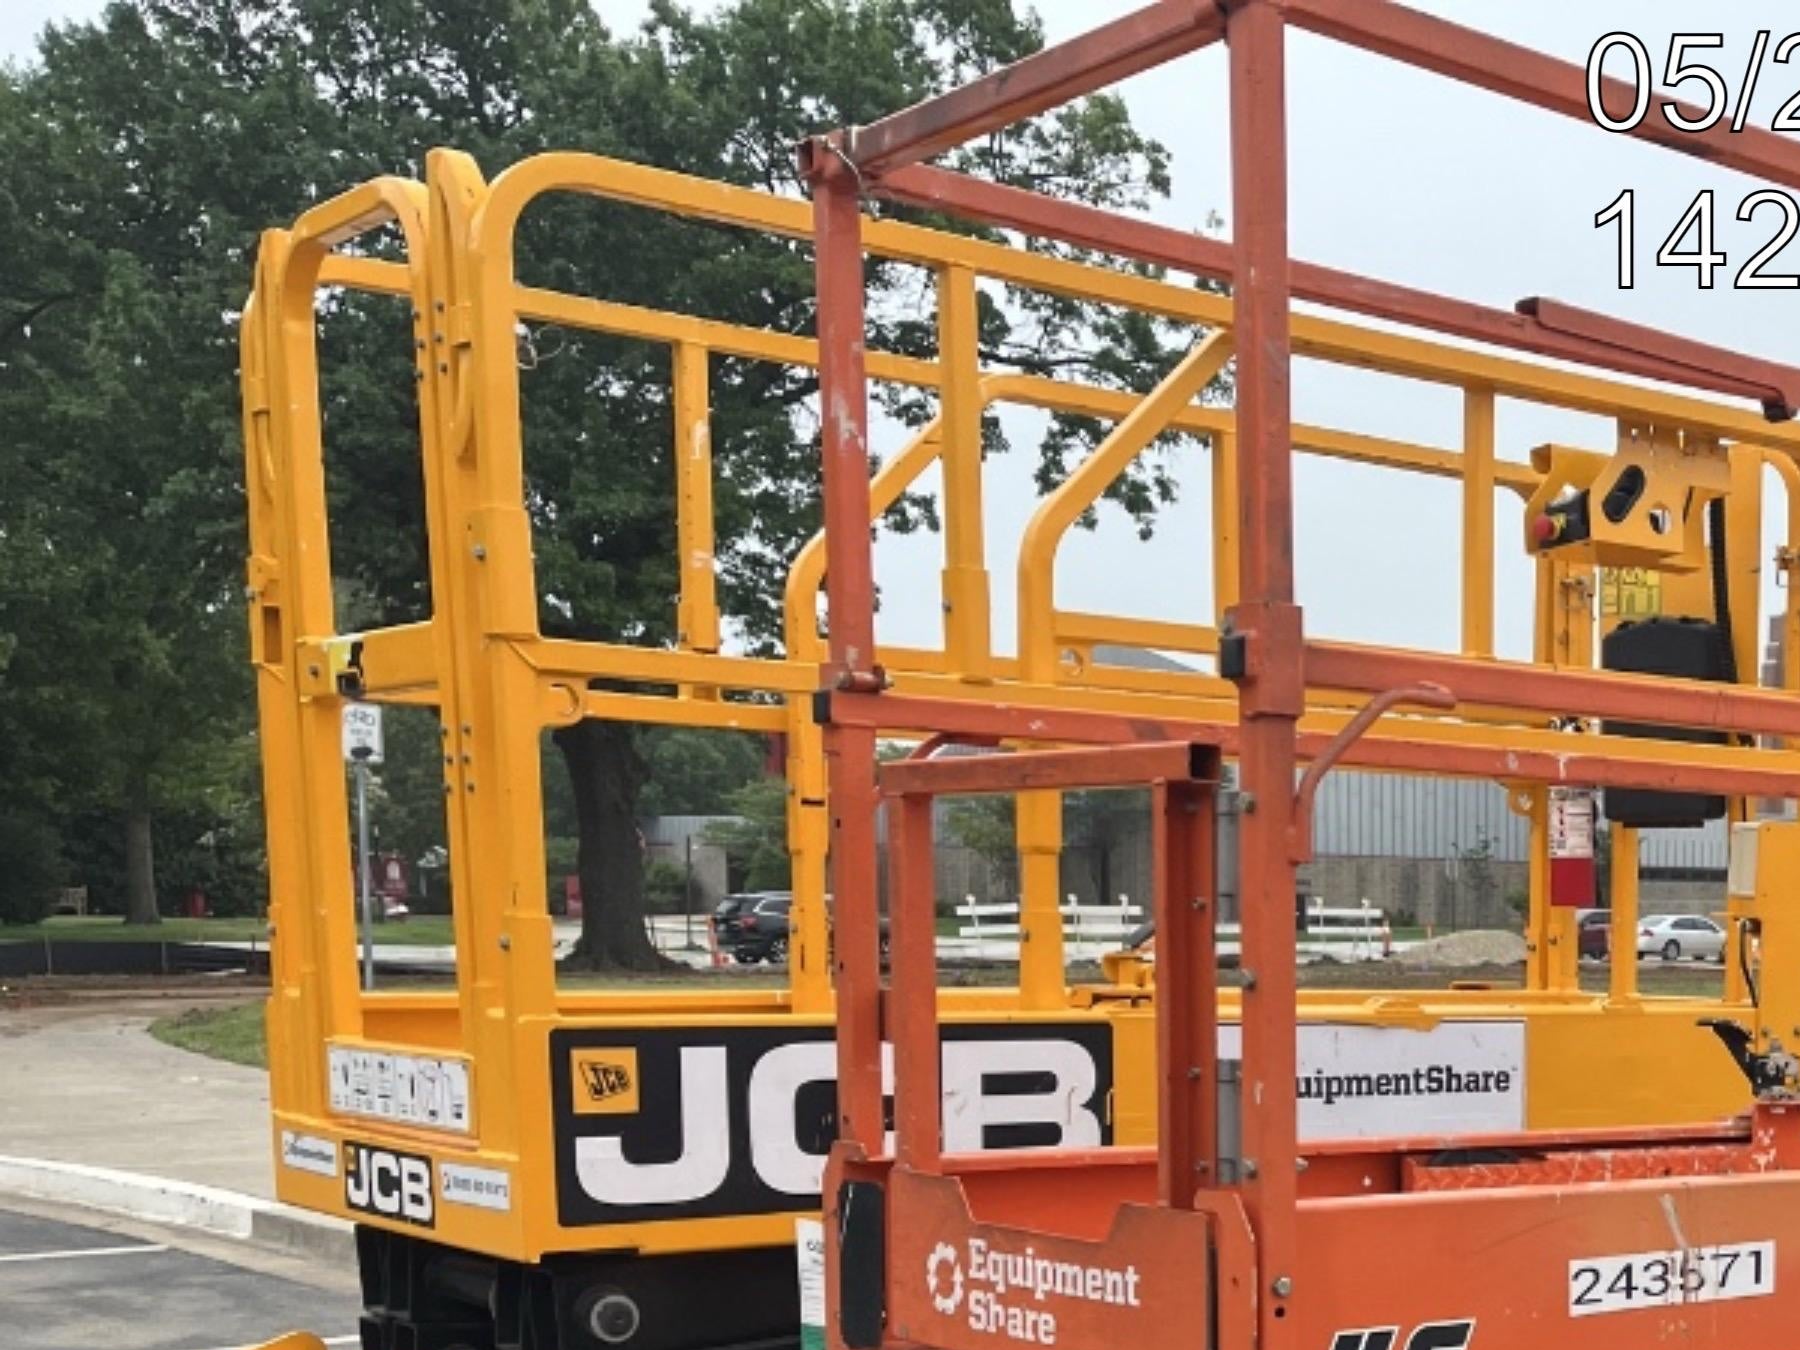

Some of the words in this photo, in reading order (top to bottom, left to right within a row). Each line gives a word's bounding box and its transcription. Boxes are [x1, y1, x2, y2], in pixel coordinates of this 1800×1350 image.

[573, 1040, 1101, 1205] JCB
[347, 1147, 434, 1222] JCB
[967, 1238, 1141, 1307] Equipment
[1572, 1250, 1763, 1306] 243571
[967, 1297, 1057, 1346] Share
